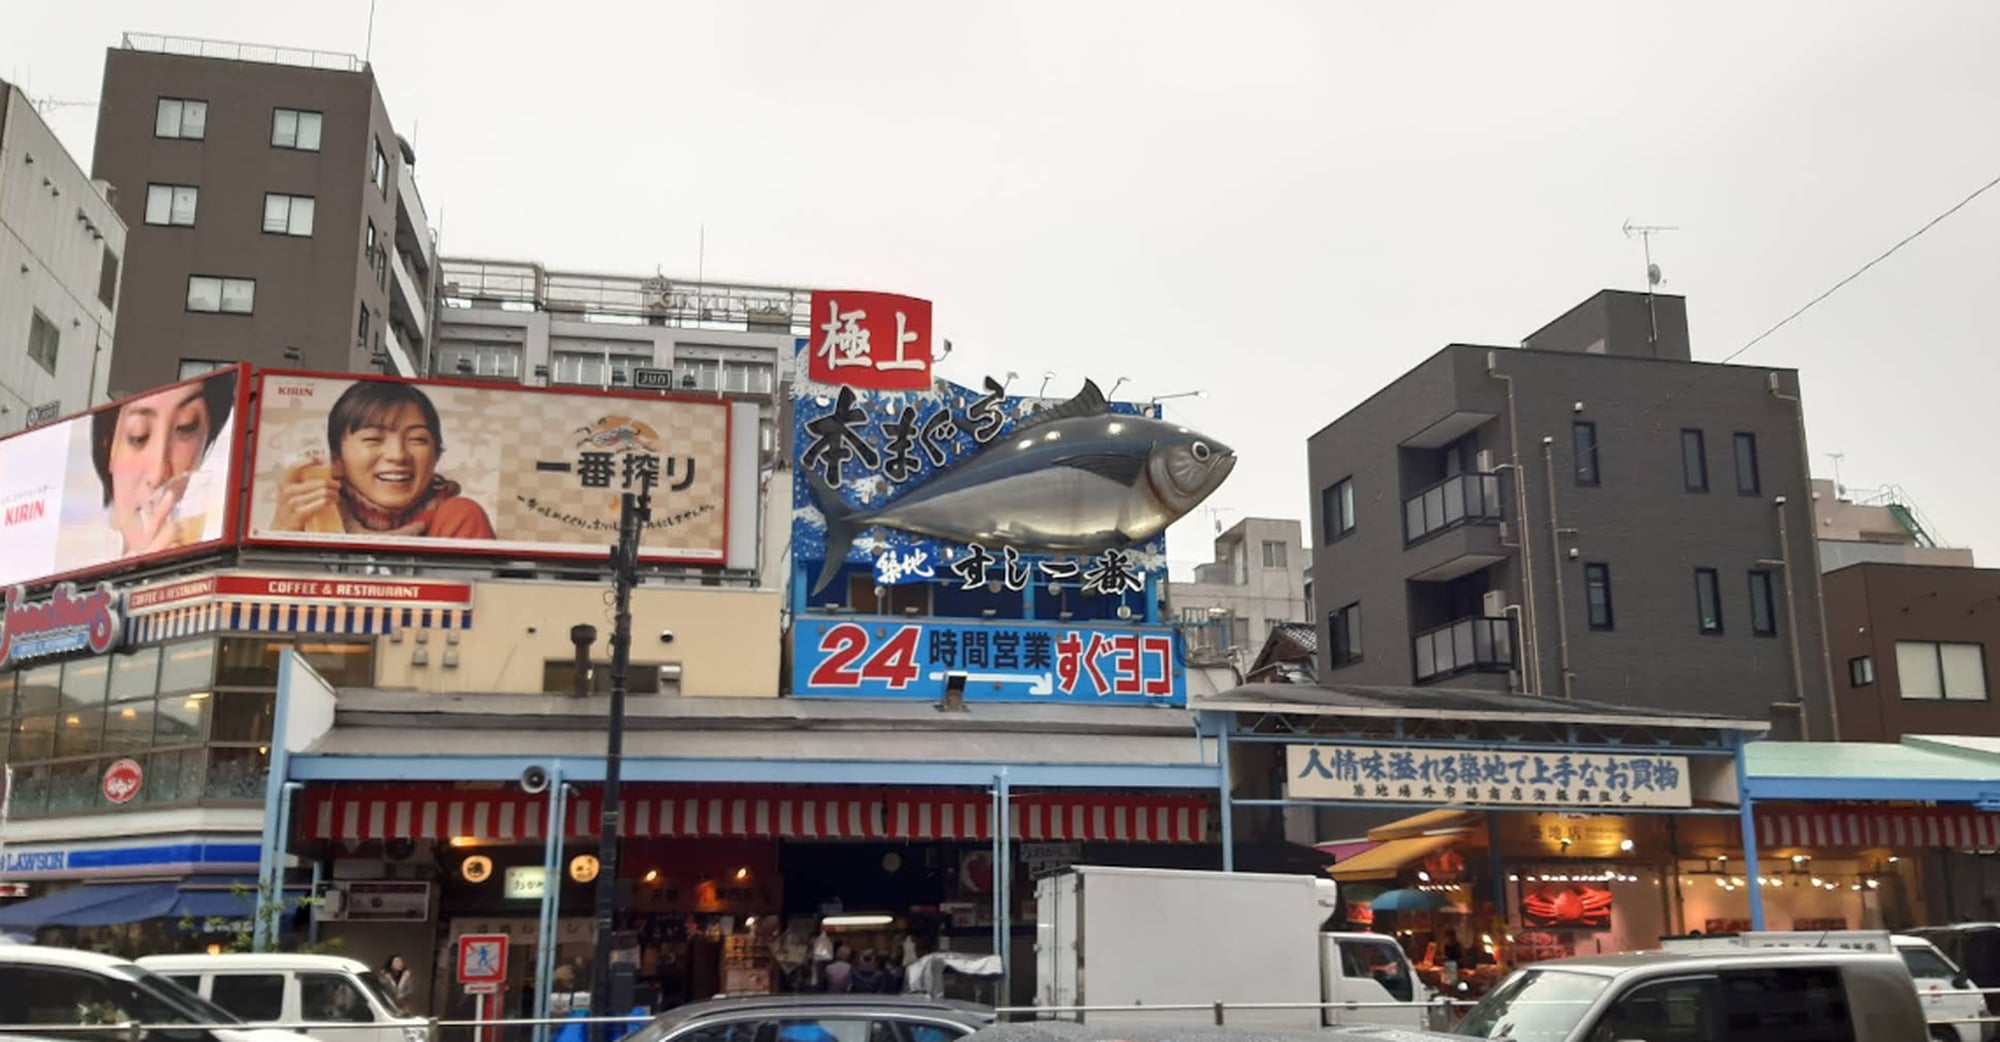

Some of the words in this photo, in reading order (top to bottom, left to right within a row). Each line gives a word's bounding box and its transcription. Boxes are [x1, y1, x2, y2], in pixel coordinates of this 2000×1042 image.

[817, 301, 926, 371] 極上
[278, 387, 313, 397] KIRIN
[801, 377, 1006, 488] 本まぐろ
[535, 451, 696, 492] 一番搾り
[4, 500, 45, 527] KIRIN
[268, 581, 316, 594] COFFEE
[322, 583, 333, 595] &
[336, 584, 421, 598] RESTAURANT
[877, 550, 933, 581] 築地
[955, 544, 1142, 594] すし一番
[1298, 748, 1680, 791] 人情味溢れる築地で上手なお買物
[7, 852, 64, 871] LAWSON
